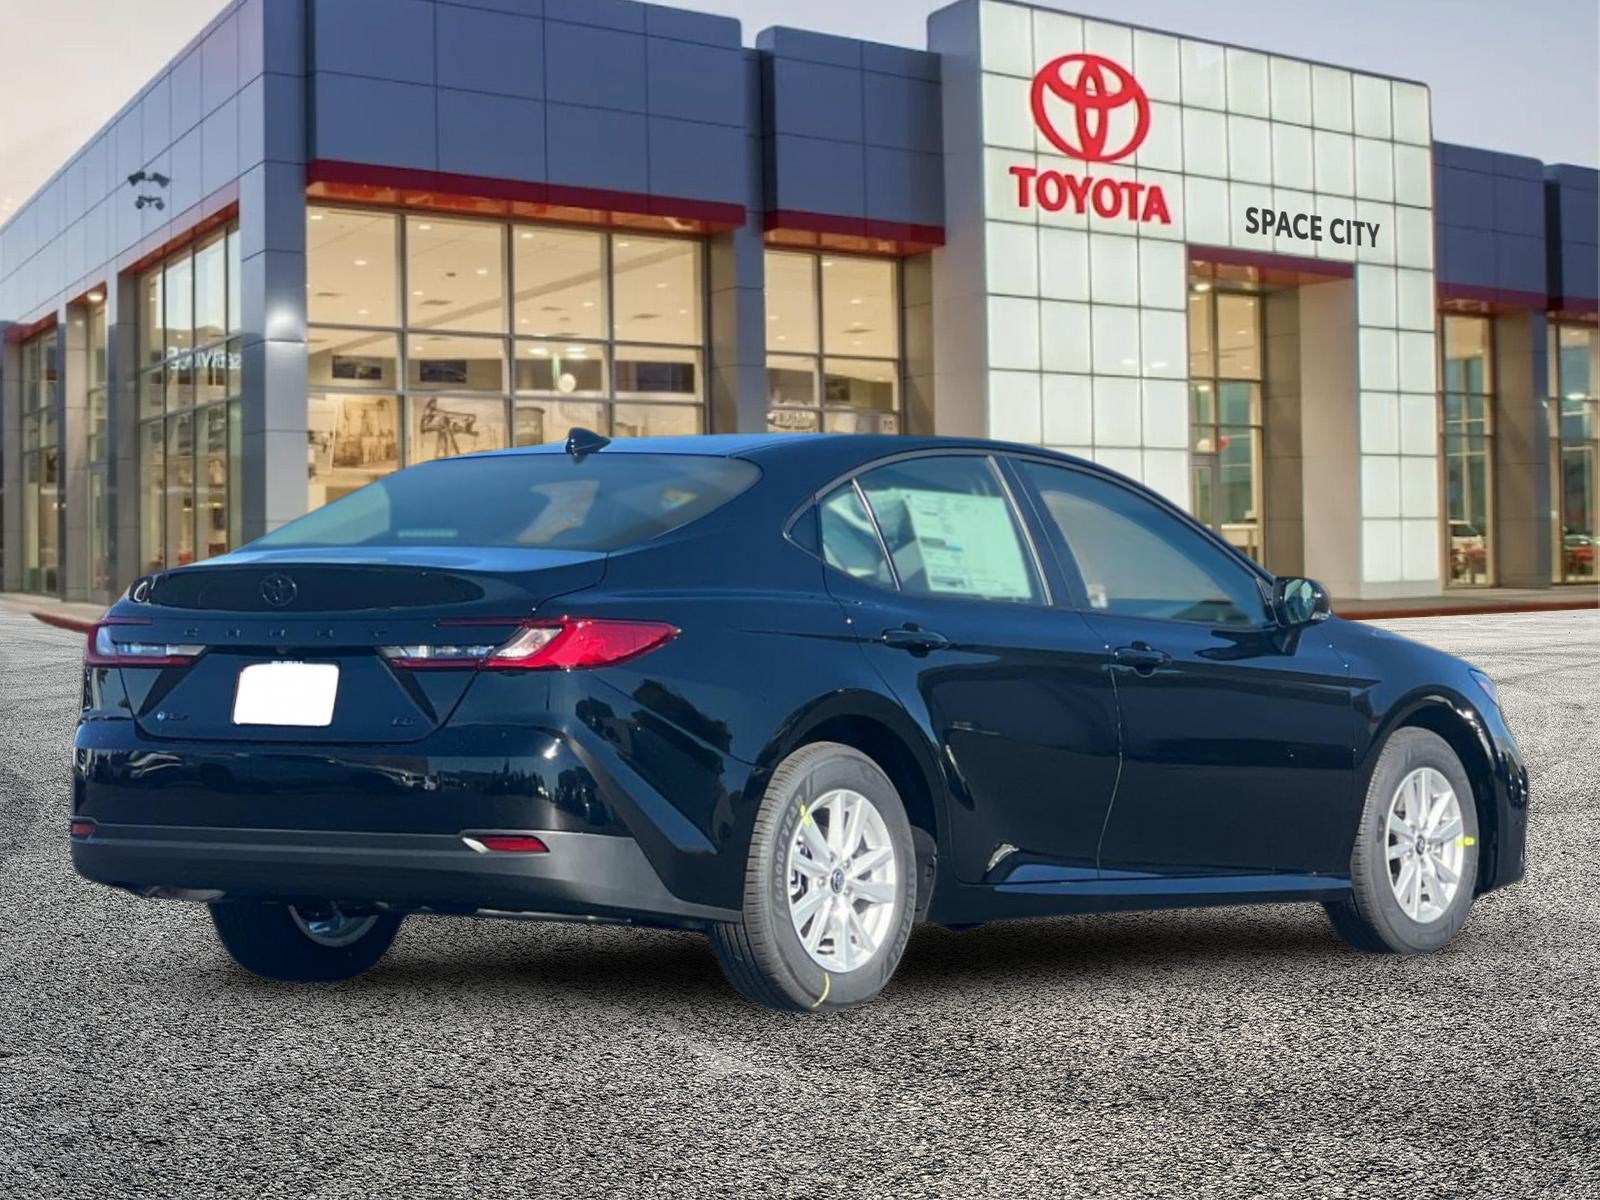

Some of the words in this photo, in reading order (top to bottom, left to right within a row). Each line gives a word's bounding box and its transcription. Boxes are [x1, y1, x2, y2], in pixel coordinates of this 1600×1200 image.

[1009, 166, 1171, 225] TOYOTA
[1245, 206, 1323, 242] SPACE
[1329, 218, 1381, 248] CITY
